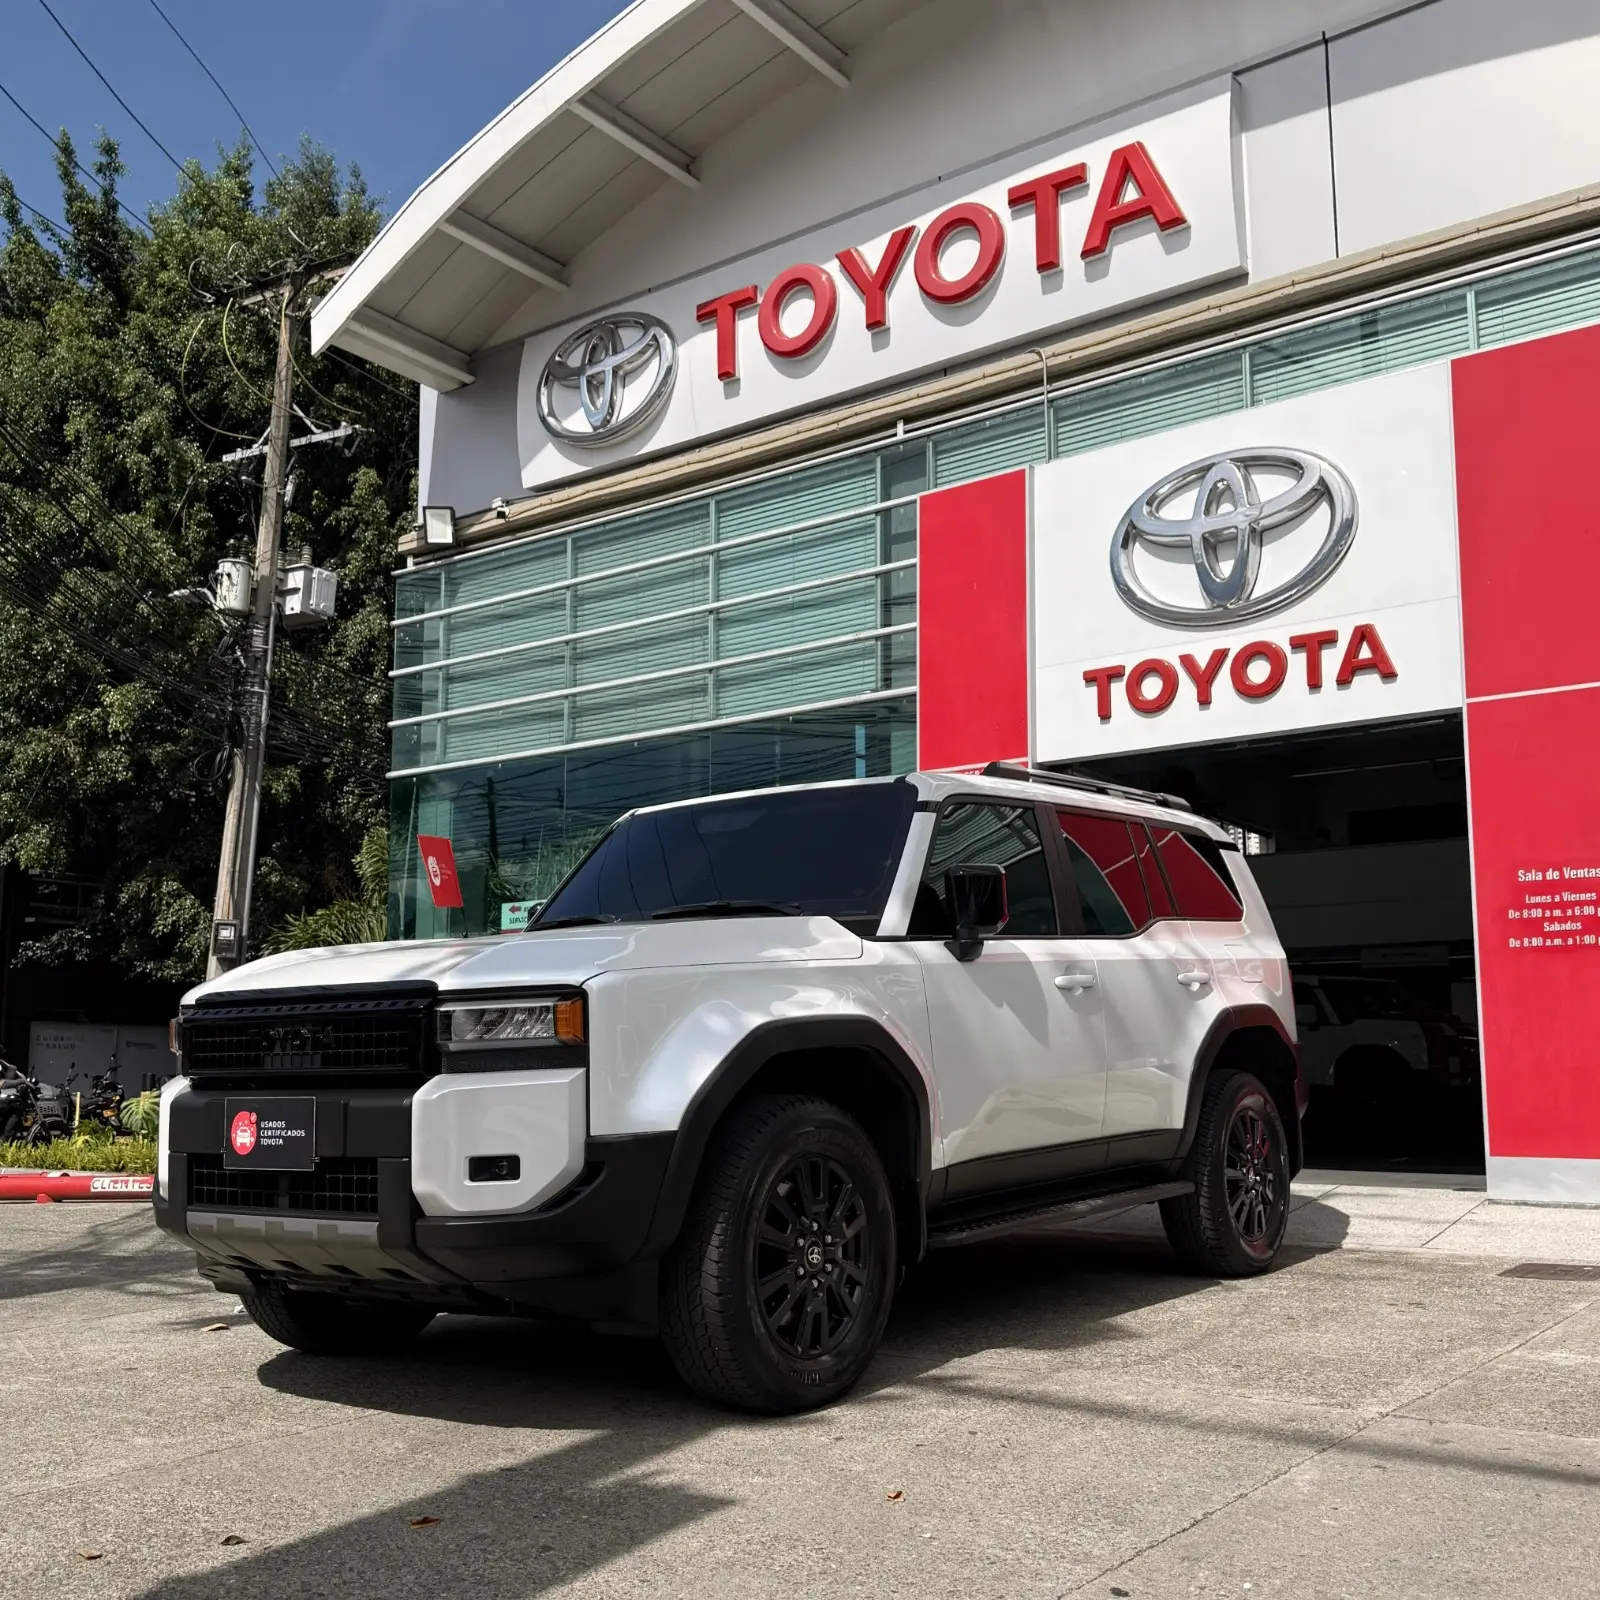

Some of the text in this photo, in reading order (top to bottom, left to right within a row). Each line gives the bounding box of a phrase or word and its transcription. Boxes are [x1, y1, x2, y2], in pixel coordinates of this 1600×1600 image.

[696, 140, 1189, 381] TOYOTA
[1083, 623, 1398, 719] TOYOTA
[1517, 866, 1600, 882] Sala de Ventas
[1525, 891, 1597, 904] Lunes a Viernes
[1508, 909, 1520, 919] De
[1522, 908, 1543, 918] 8:00
[1566, 908, 1572, 916] a
[1574, 905, 1595, 916] 6:00
[1543, 920, 1582, 932] Sabados
[1509, 937, 1521, 948] De
[1523, 936, 1543, 947] 8:00
[1545, 938, 1565, 946] a.m.
[1567, 937, 1573, 945] a
[1575, 934, 1596, 945] 1:00
[260, 1120, 286, 1128] USADOS
[260, 1129, 306, 1137] CERTIFICADOS
[260, 1138, 284, 1146] TOYOTA
